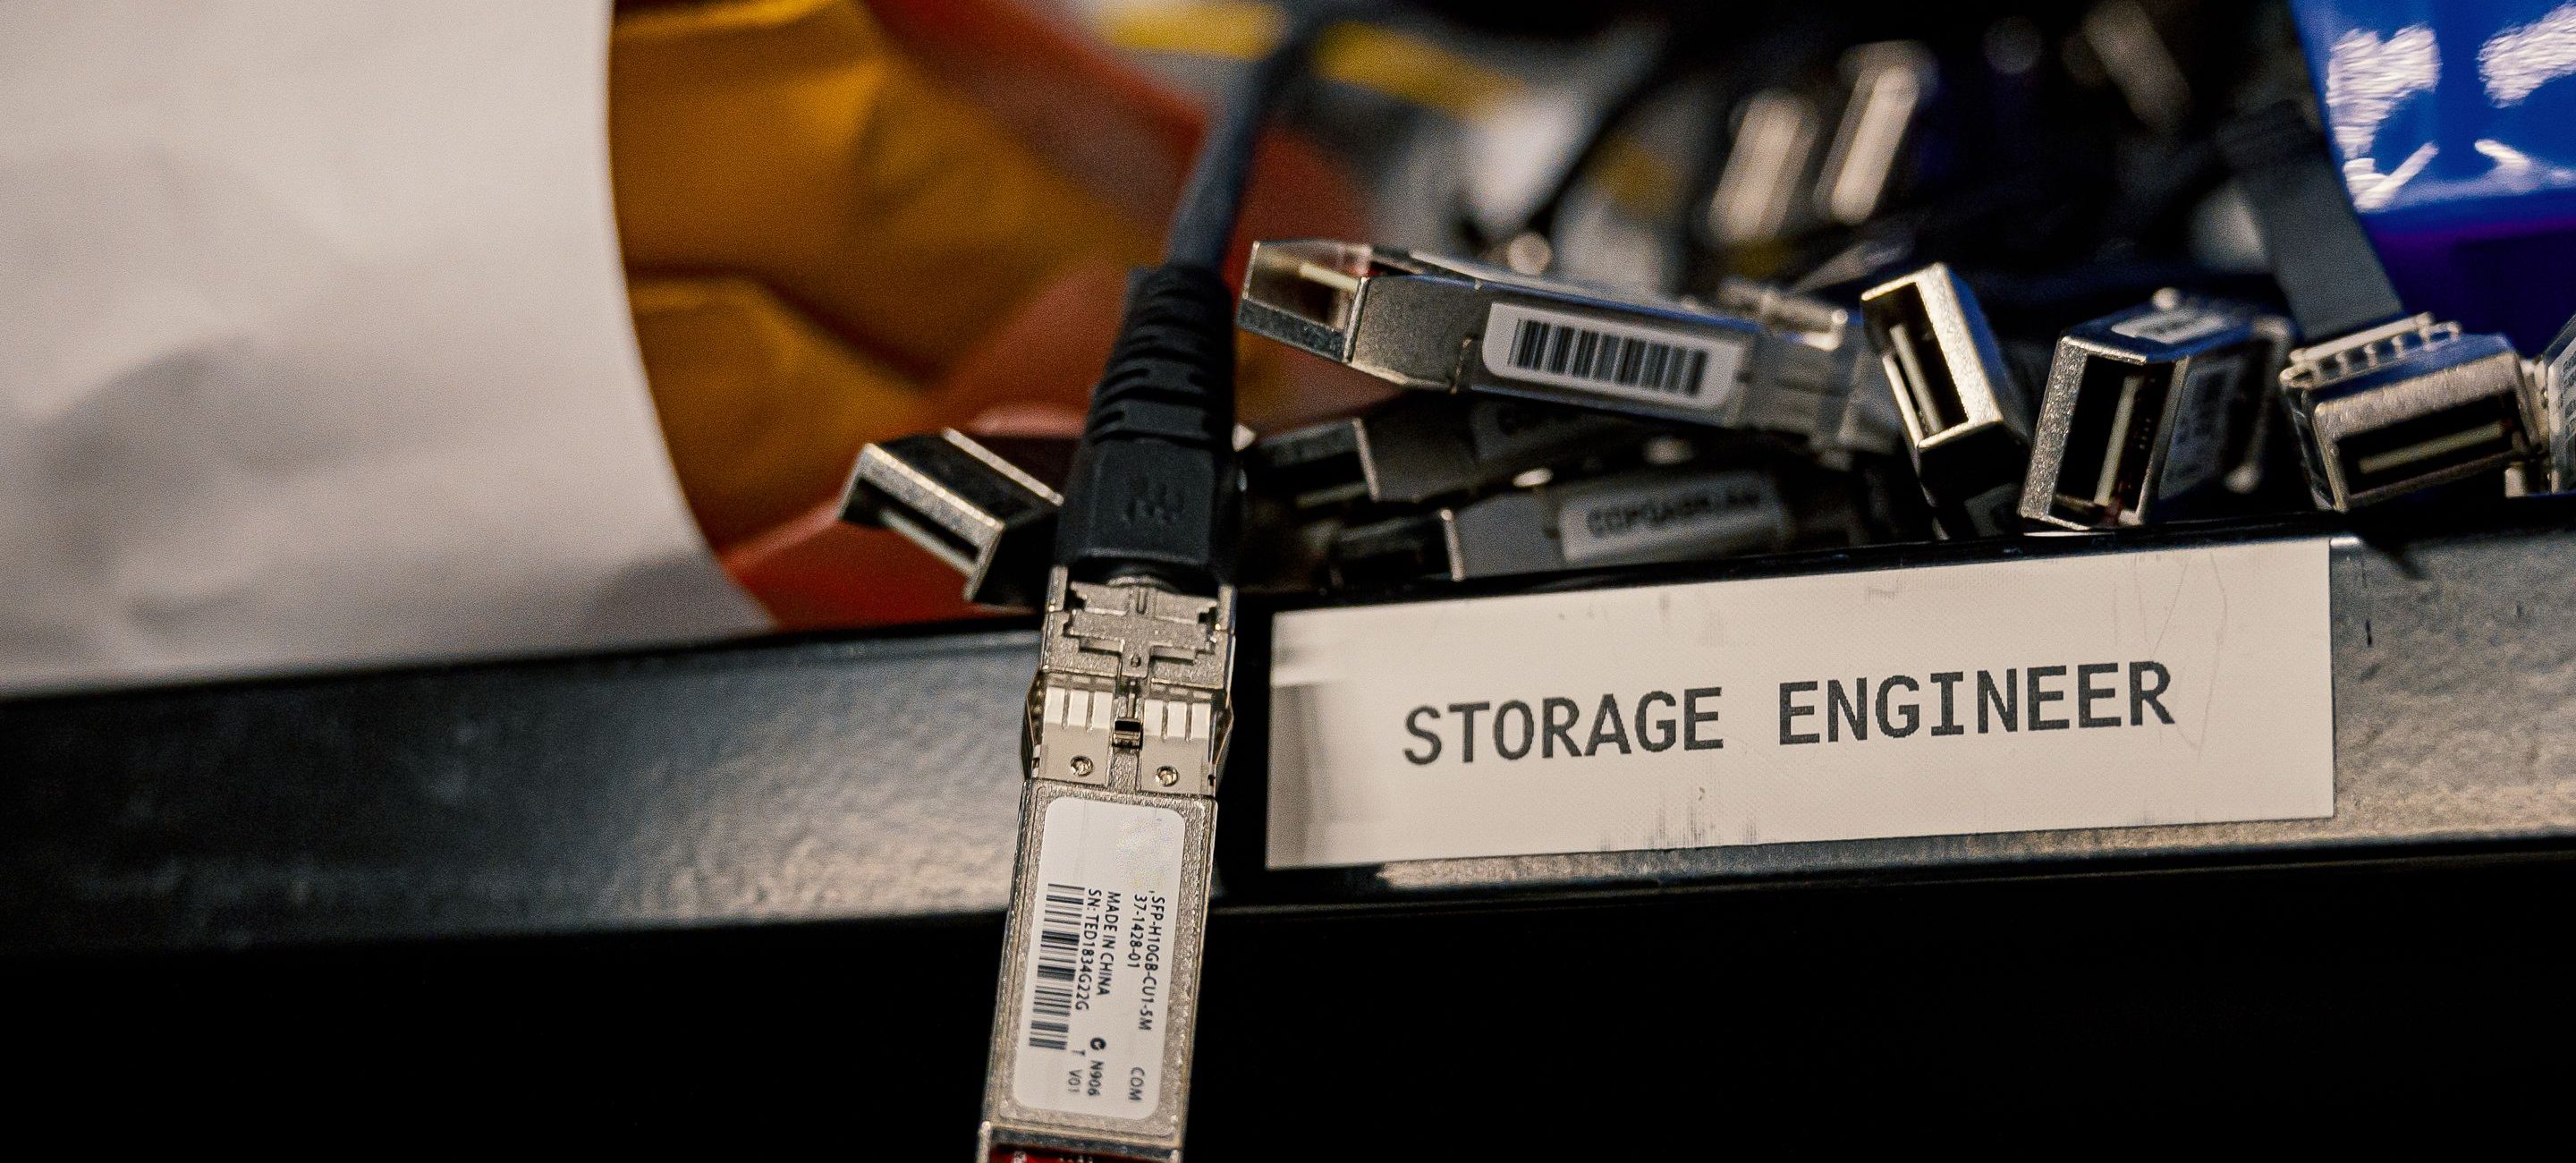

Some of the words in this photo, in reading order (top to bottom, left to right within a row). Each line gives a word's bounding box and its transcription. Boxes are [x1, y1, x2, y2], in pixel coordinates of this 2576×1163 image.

[1403, 686, 1724, 767] STORAGE
[1778, 660, 2176, 747] ENGINEER
[1086, 888, 1103, 912] SN:
[1104, 890, 1122, 932] MADE
[1102, 934, 1116, 950] IN
[1127, 894, 1148, 969] 37-1428-01
[1074, 913, 1100, 1011] TED1834G22G
[1096, 952, 1114, 996] CHINA
[1067, 1069, 1082, 1093] V01
[1087, 1059, 1105, 1097] N906
[1128, 1066, 1146, 1101] COM
